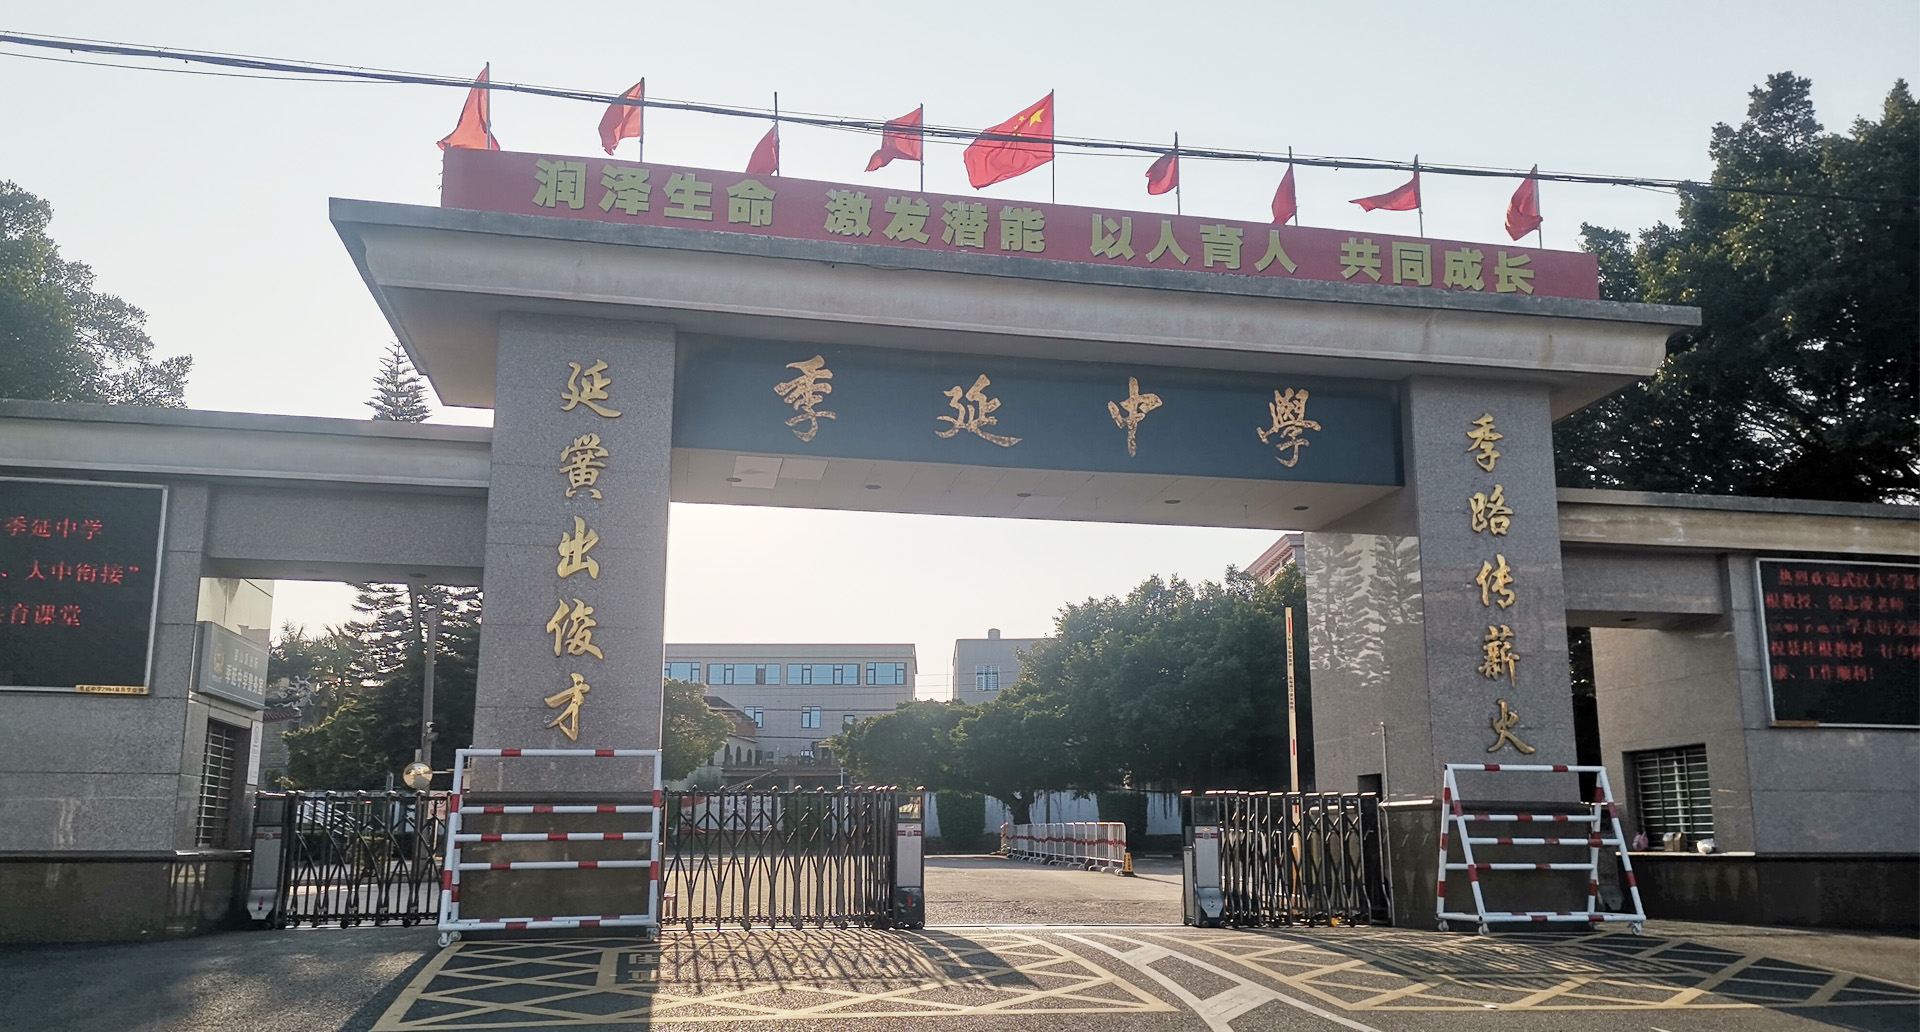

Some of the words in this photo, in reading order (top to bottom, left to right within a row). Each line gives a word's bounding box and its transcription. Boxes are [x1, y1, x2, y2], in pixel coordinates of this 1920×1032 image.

[532, 158, 776, 226] 润泽生命
[824, 189, 1046, 252] 激发潜能
[1091, 213, 1298, 274] 以人育人
[1340, 237, 1535, 294] 共同成长
[773, 354, 1322, 468] 季延中學
[0, 603, 81, 626] 育课堂
